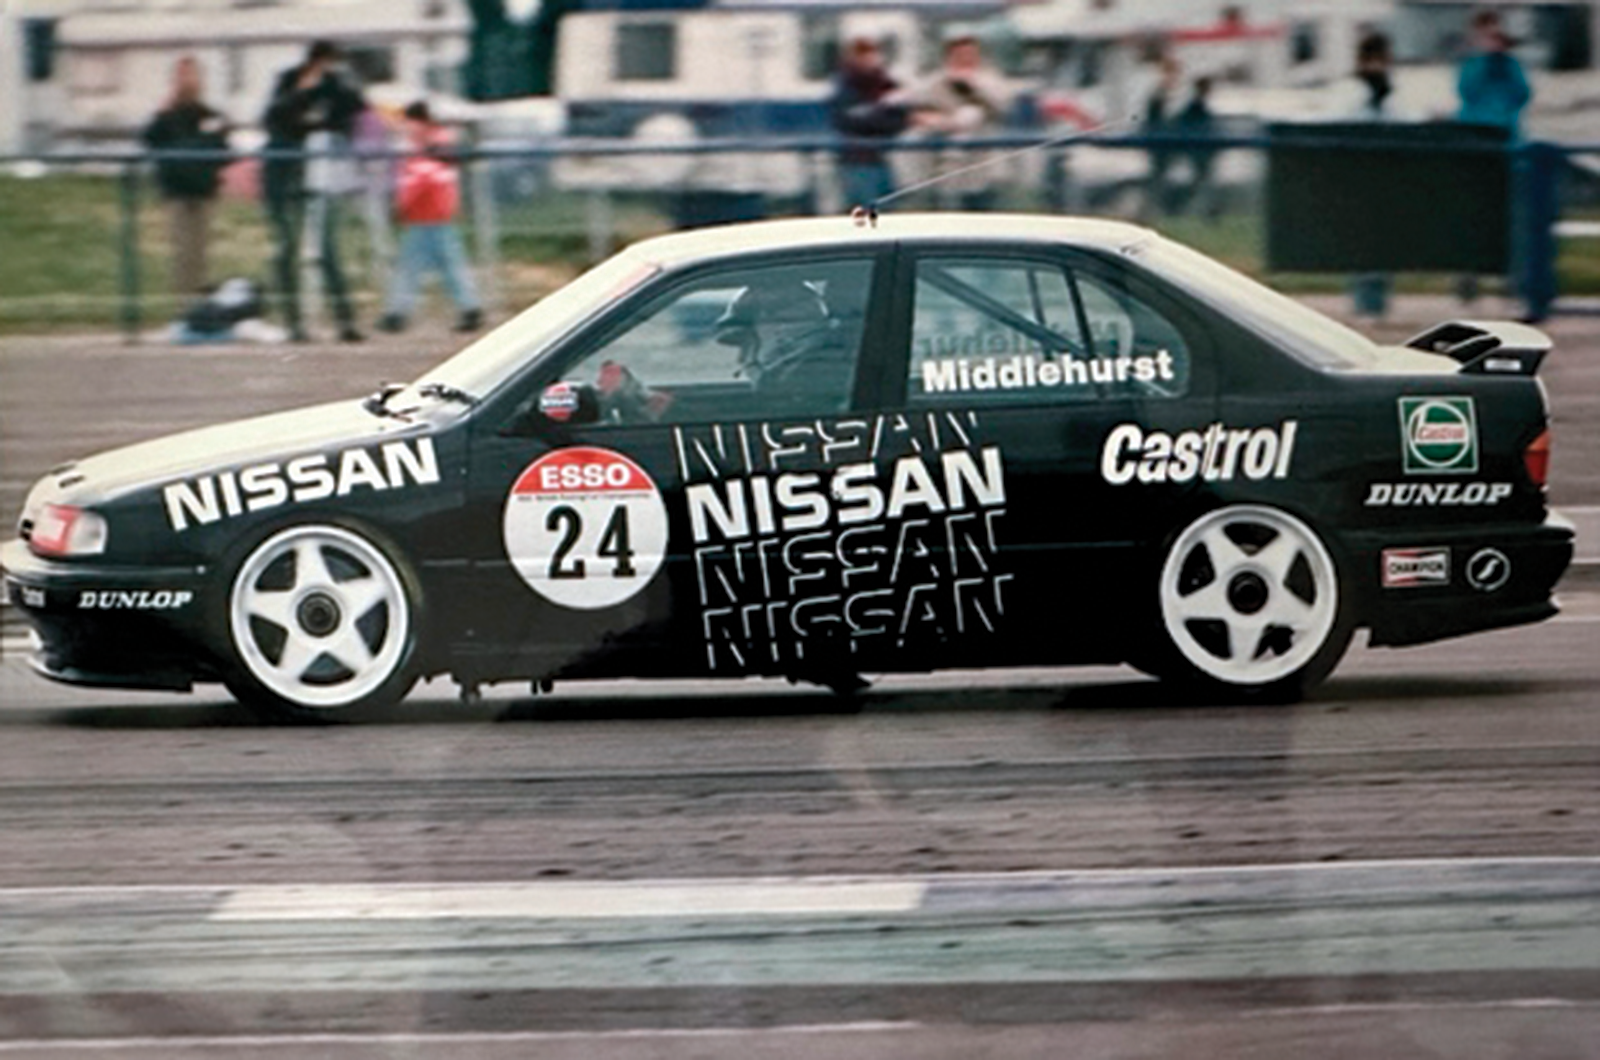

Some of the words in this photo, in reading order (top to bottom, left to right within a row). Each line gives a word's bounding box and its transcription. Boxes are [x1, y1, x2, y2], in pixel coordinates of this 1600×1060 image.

[922, 349, 1174, 393] Middlehurst
[163, 437, 440, 531] NISSAN
[540, 462, 632, 490] ESSO
[1101, 420, 1298, 485] Castrol
[685, 447, 1007, 543] NISSAN
[1363, 481, 1514, 507] DUNLOP
[545, 504, 637, 579] 24
[695, 508, 1007, 606] NISSAN
[76, 590, 193, 610] DUNLOP
